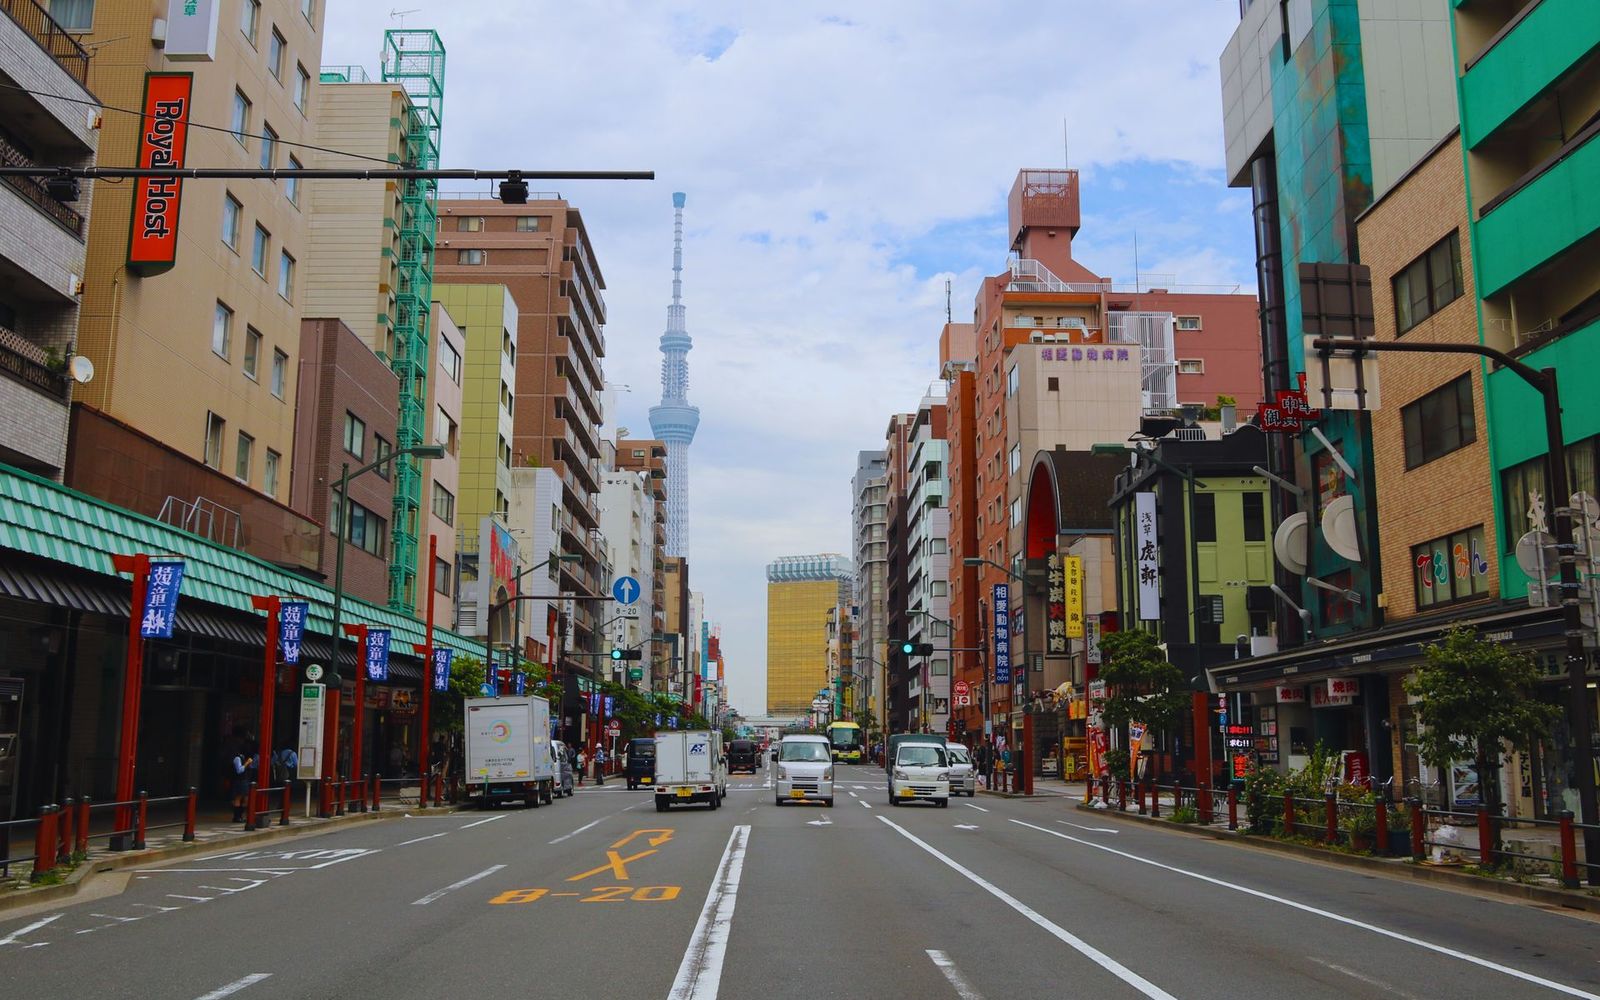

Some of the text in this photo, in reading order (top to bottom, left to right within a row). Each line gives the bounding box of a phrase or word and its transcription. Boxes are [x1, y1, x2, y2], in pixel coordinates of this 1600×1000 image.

[143, 98, 184, 239] Royal Host
[996, 586, 1009, 667] 相愛動物病院
[1280, 687, 1304, 701] 焼肉
[1332, 680, 1357, 693] 焼肉
[487, 885, 682, 905] 8-20
